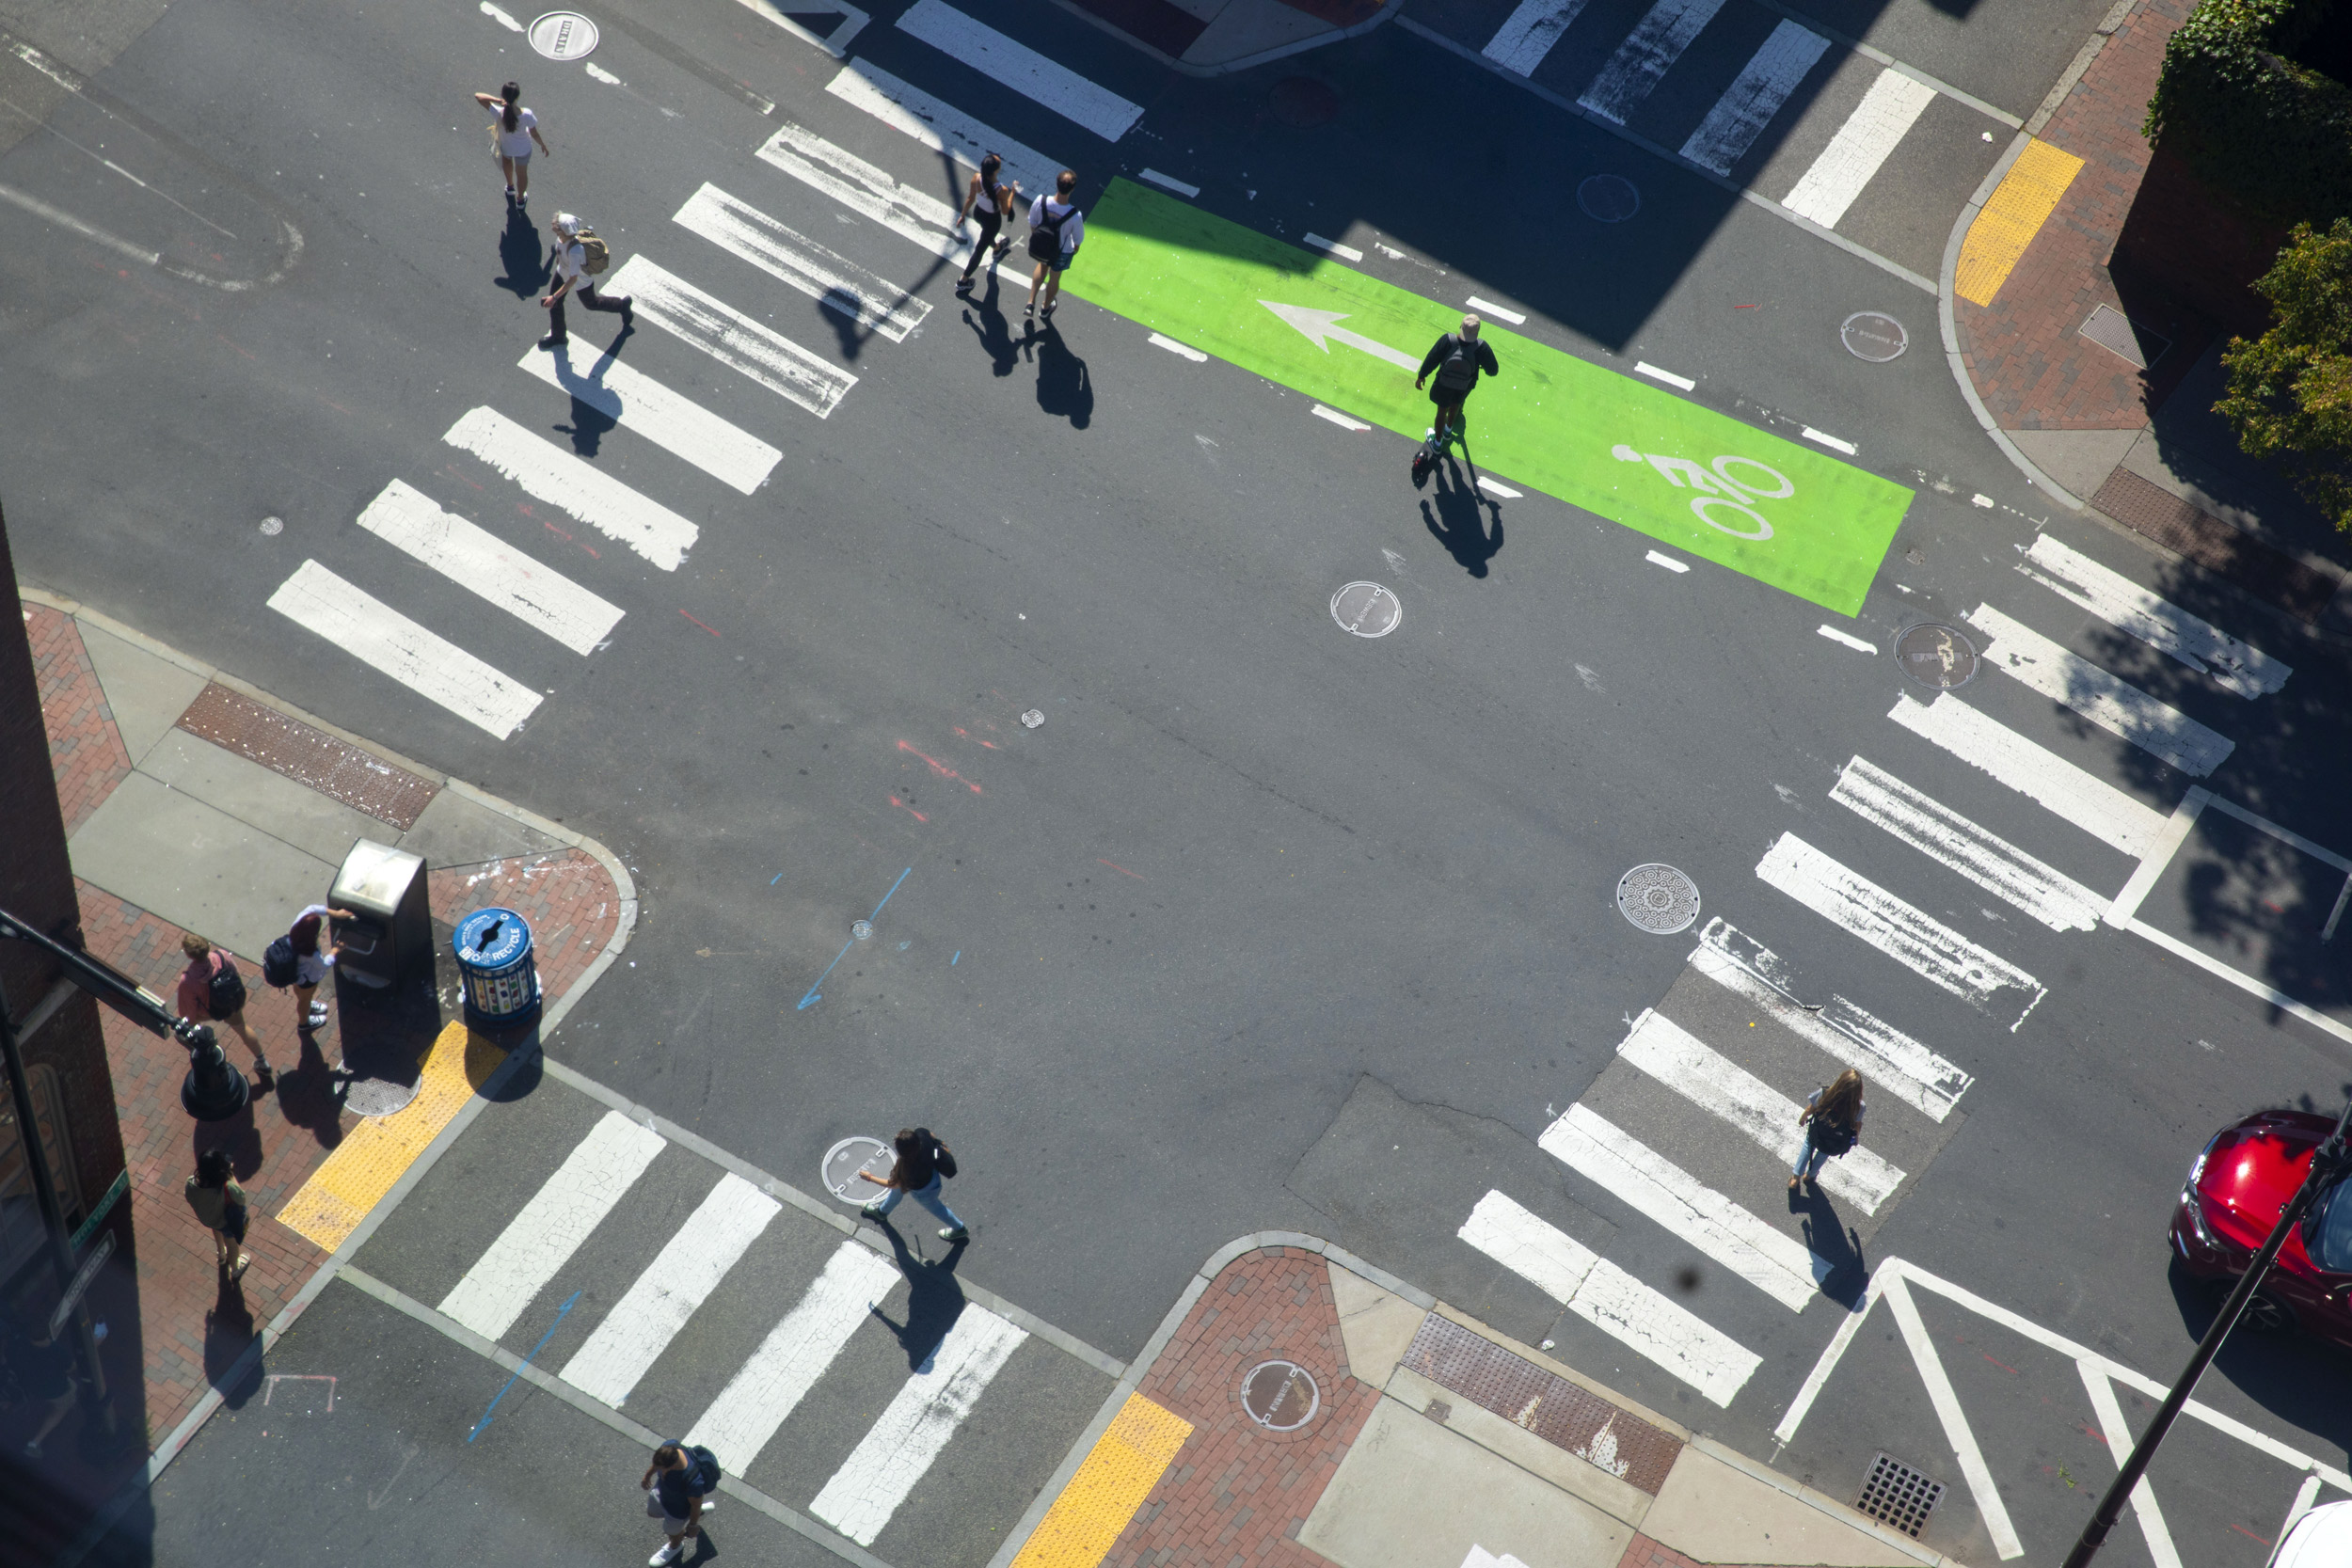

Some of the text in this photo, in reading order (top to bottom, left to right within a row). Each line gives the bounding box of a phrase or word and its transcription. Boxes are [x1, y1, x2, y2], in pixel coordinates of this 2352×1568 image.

[555, 22, 571, 53] DRAIN
[492, 927, 520, 961] RECYCLE
[67, 1247, 106, 1304] ONE WAY
